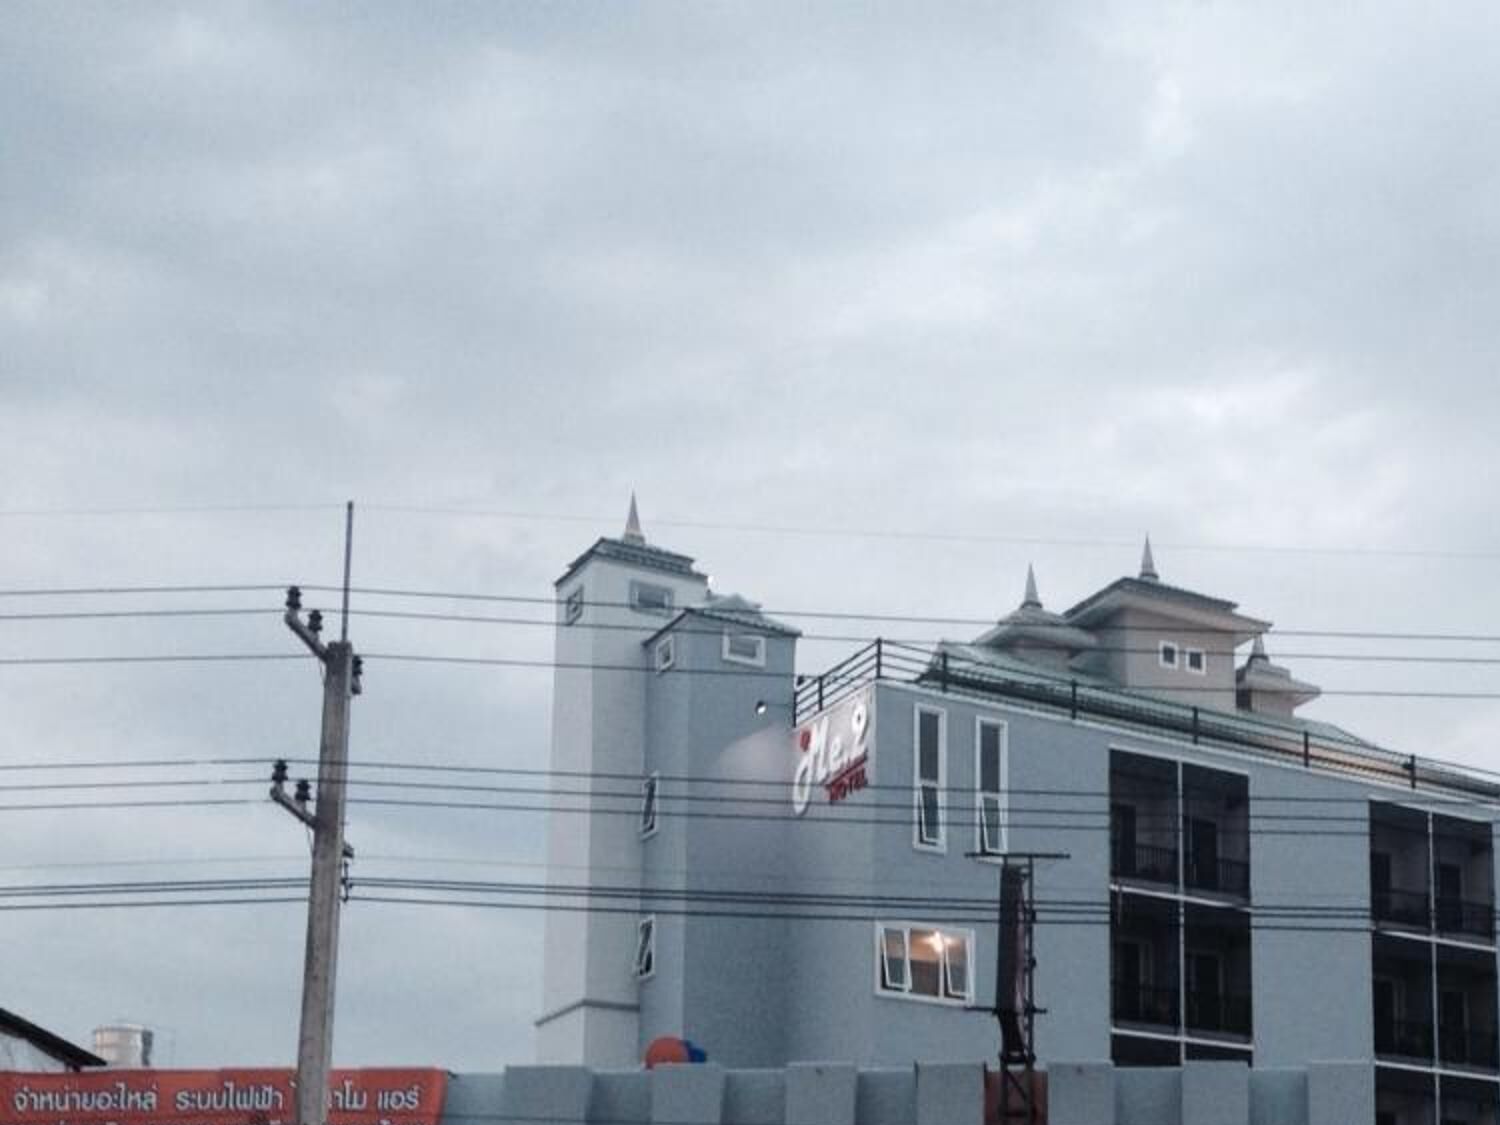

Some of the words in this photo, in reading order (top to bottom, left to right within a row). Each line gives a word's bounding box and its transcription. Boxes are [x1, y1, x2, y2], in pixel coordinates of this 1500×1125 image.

[15, 1082, 158, 1112] จำหน่ายอะไหล่
[176, 1081, 283, 1111] ระบบไฟฟ้า
